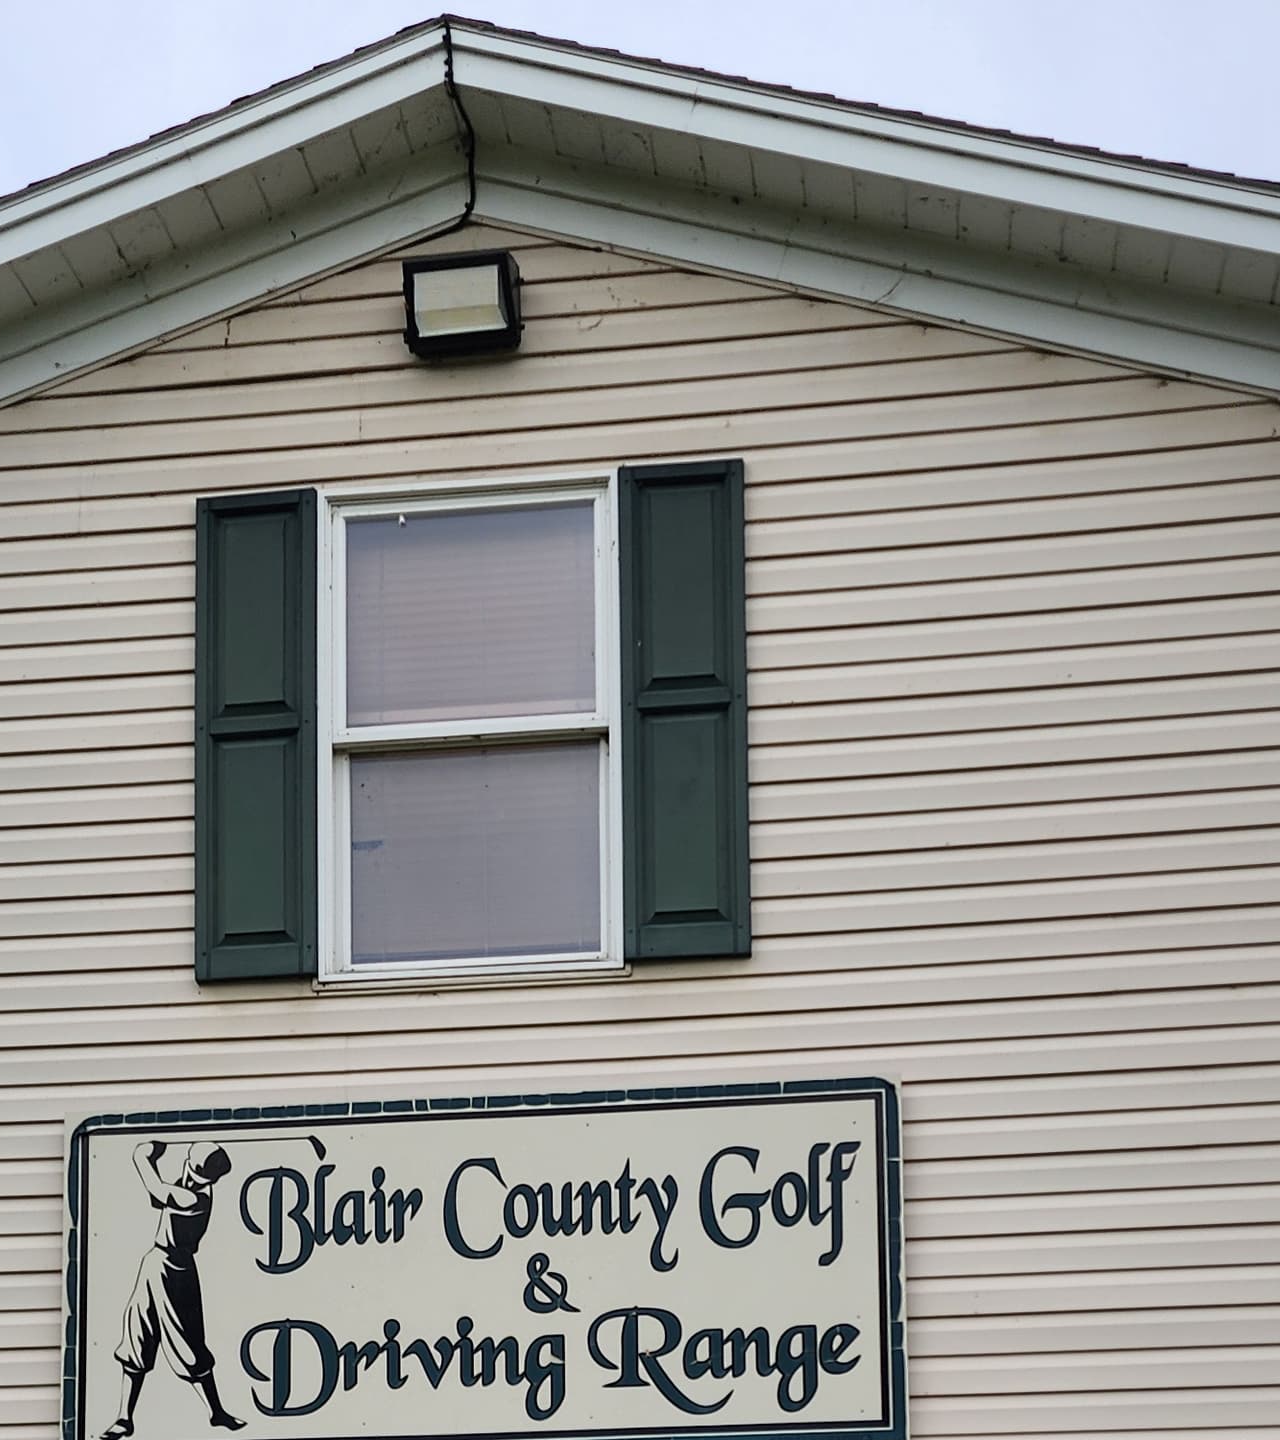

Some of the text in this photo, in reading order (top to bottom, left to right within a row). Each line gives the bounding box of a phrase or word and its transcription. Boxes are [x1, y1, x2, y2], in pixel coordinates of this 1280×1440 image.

[240, 1140, 862, 1275] Blair County Golf
[523, 1253, 581, 1313] &
[240, 1306, 863, 1422] Driving Range
